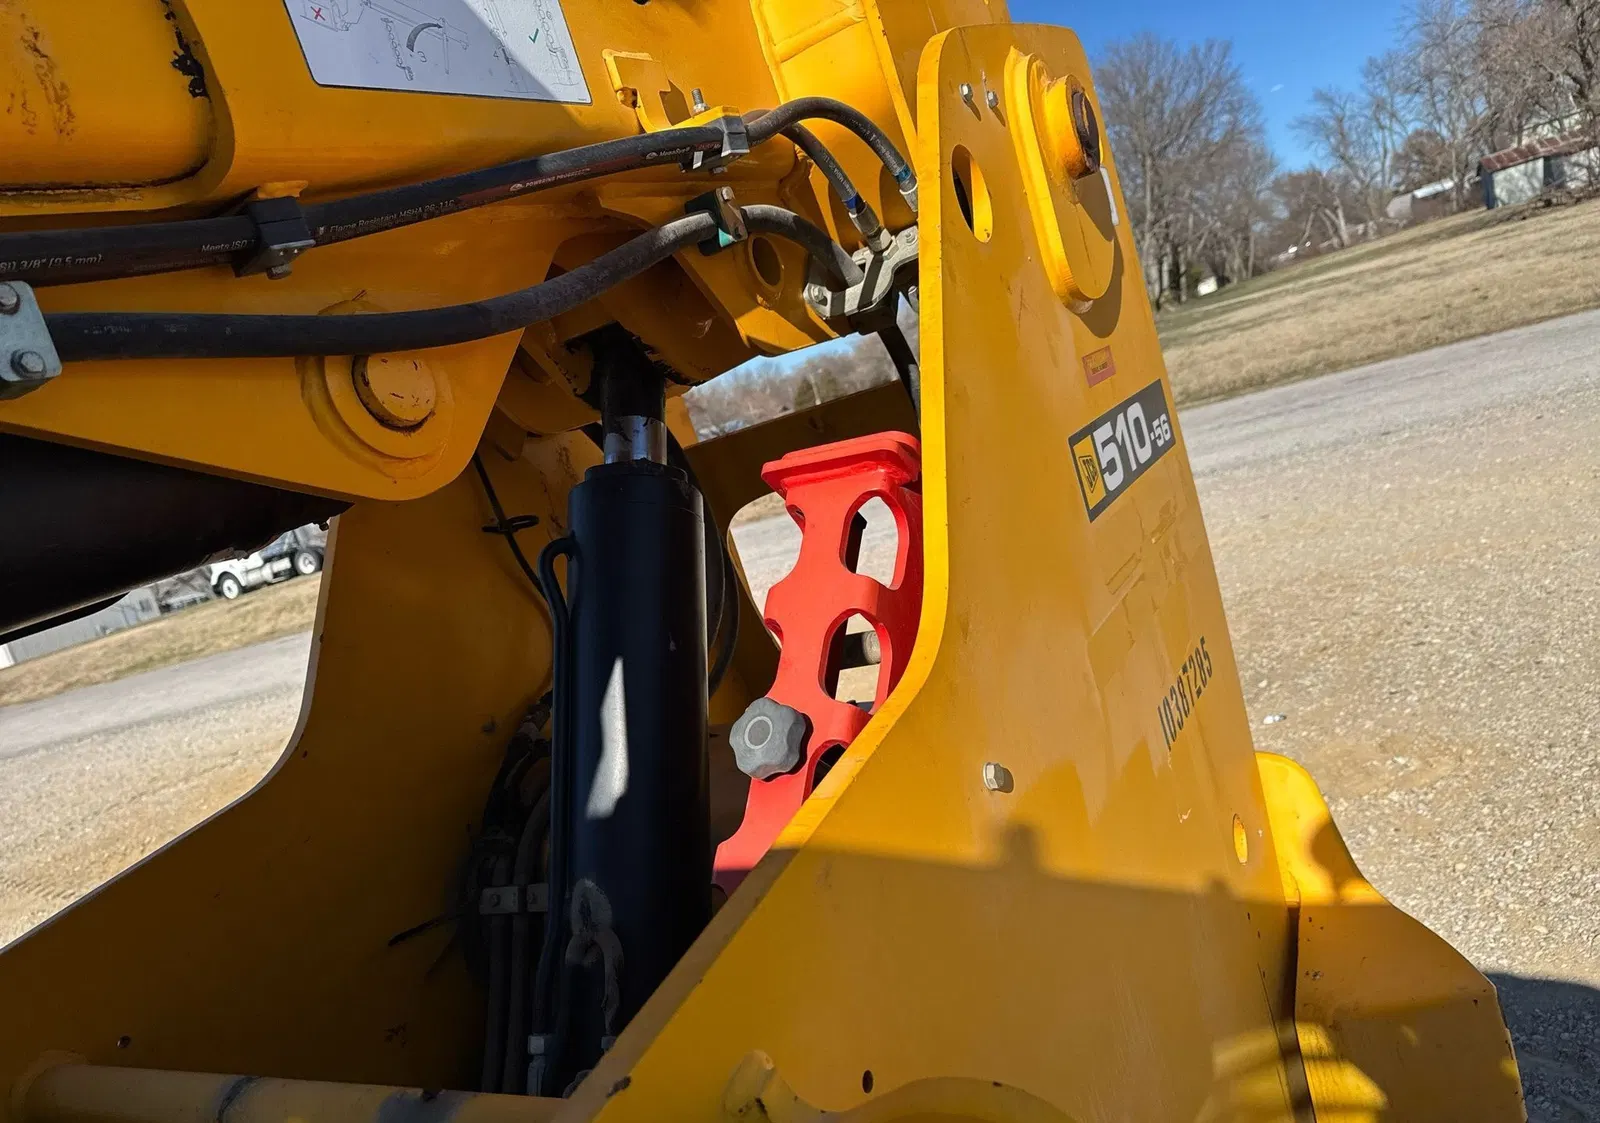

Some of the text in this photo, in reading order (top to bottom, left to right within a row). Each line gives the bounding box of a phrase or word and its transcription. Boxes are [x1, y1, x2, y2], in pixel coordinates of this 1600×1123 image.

[329, 223, 357, 233] Flame
[358, 213, 398, 228] Resistant
[399, 206, 423, 218] MSHA
[201, 243, 231, 253] Meets
[230, 239, 248, 250] ISO
